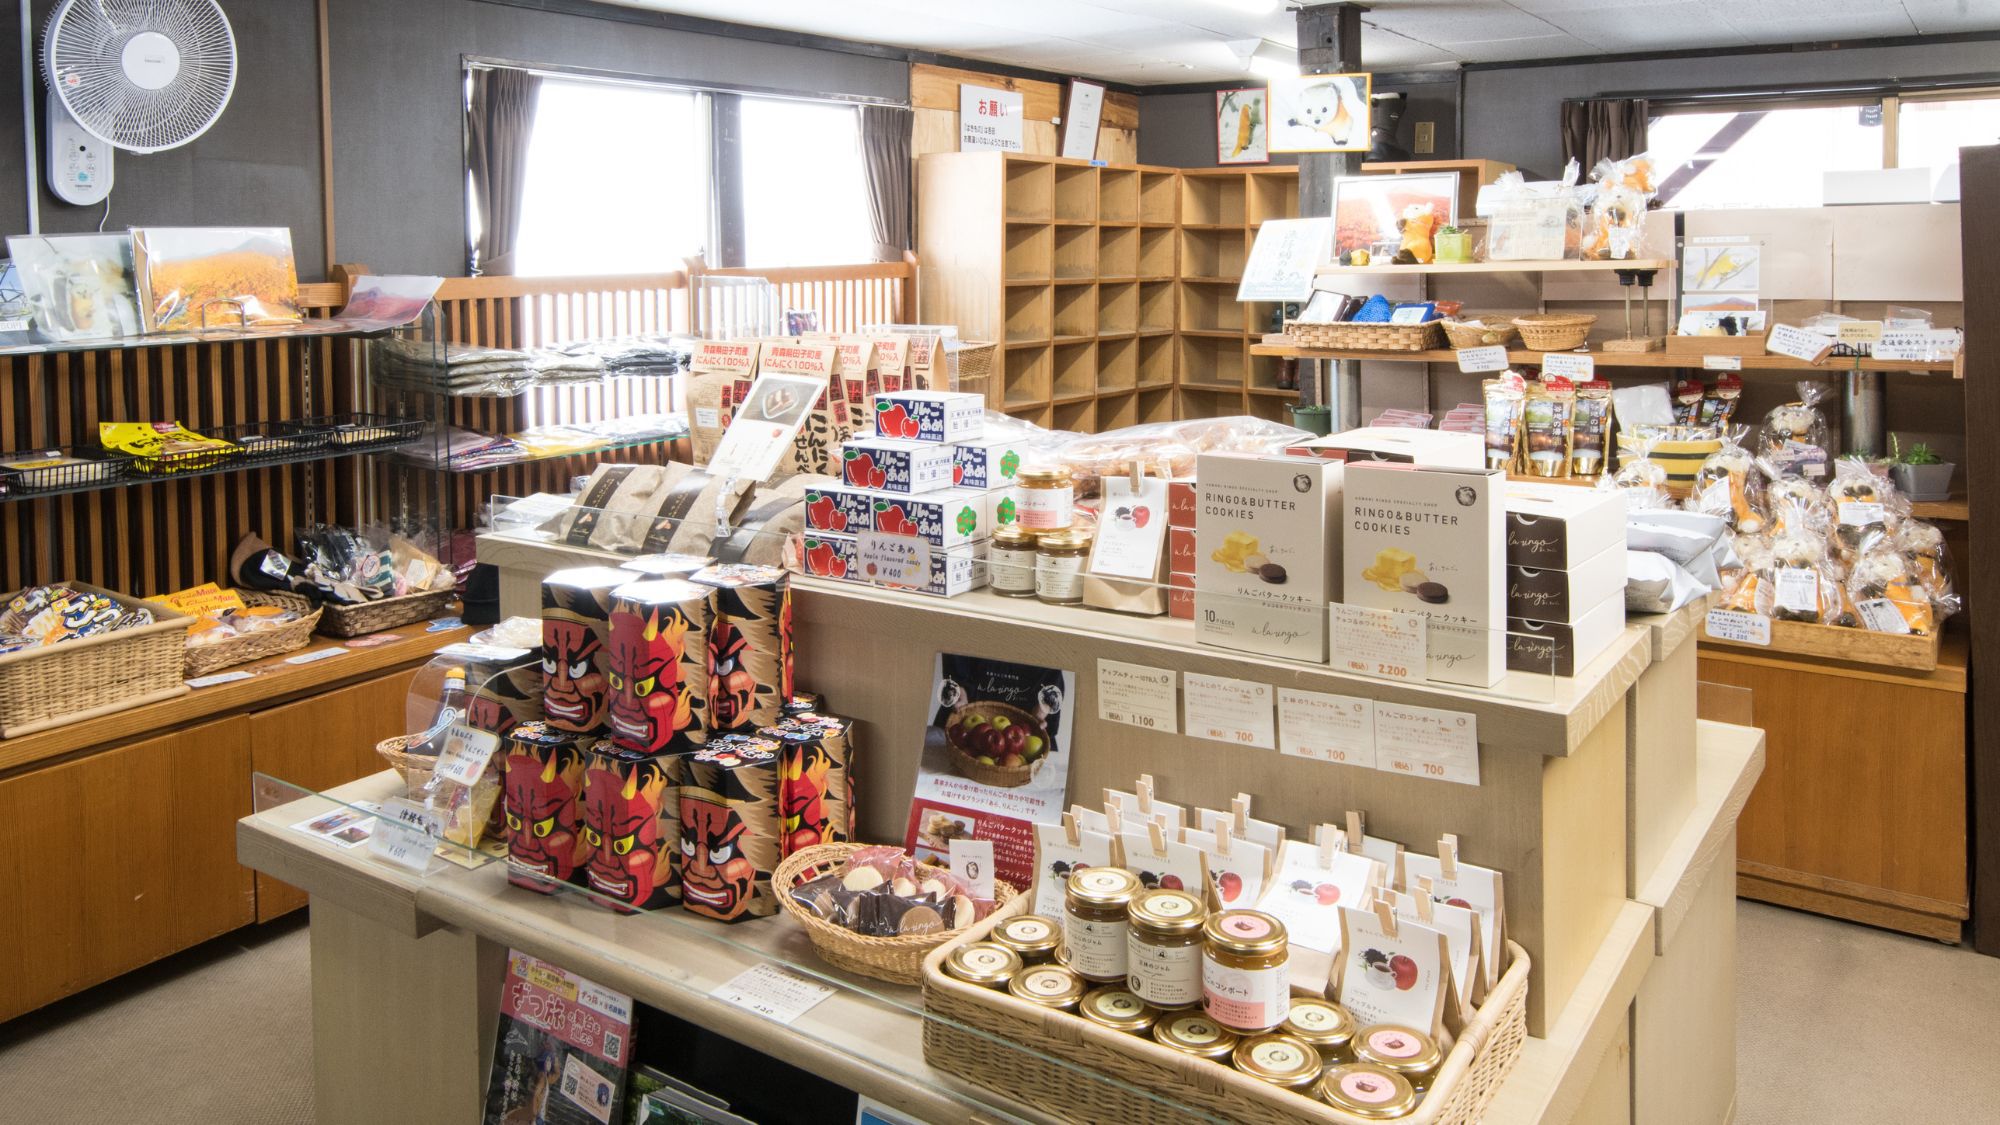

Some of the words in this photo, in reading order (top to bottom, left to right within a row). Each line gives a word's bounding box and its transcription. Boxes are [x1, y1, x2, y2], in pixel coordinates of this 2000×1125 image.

[978, 98, 1008, 117] お願い
[703, 344, 749, 357] 青森県田子町産
[771, 346, 823, 359] 青森県田子町産
[695, 356, 751, 368] にんにく100%入
[764, 358, 825, 372] にんにく100%入
[909, 400, 944, 417] りんご
[920, 416, 944, 431] あめ
[876, 450, 910, 467] りんご
[886, 467, 910, 483] あめ
[964, 462, 987, 478] あめ
[837, 492, 870, 510] りんご
[1205, 492, 1296, 511] RINGO&BUTTER
[848, 510, 870, 524] あめ
[907, 502, 942, 519] りんご
[1205, 506, 1254, 520] COOKIES
[1354, 506, 1459, 526] RINGO&BUTTER
[919, 519, 942, 535] あめ
[1354, 521, 1411, 536] COOKIES
[870, 540, 915, 554] りんごあめ
[863, 552, 879, 560] Apple
[882, 567, 902, 578] ¥400
[1237, 587, 1312, 602] りんごバタークッキー
[1204, 609, 1216, 623] 10
[1379, 709, 1444, 725] りんごのコンポート
[1235, 731, 1254, 742] 700
[1326, 749, 1346, 761] 700
[1422, 763, 1445, 776] 700
